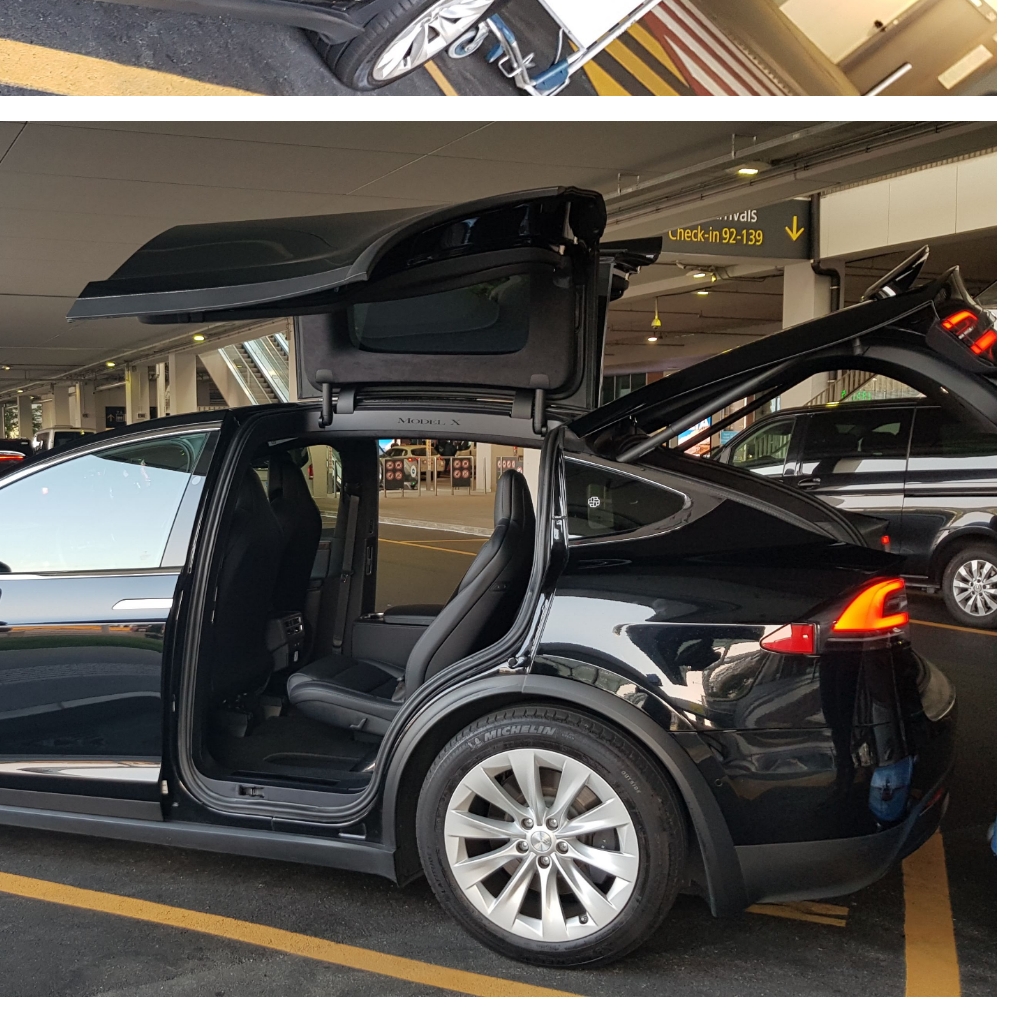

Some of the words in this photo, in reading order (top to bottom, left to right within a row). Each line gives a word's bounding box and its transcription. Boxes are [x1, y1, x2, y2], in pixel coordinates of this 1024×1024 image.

[668, 225, 720, 243] Check-in
[721, 227, 764, 246] 92-139
[397, 417, 446, 426] MODEL
[484, 725, 556, 742] MICHELIN
